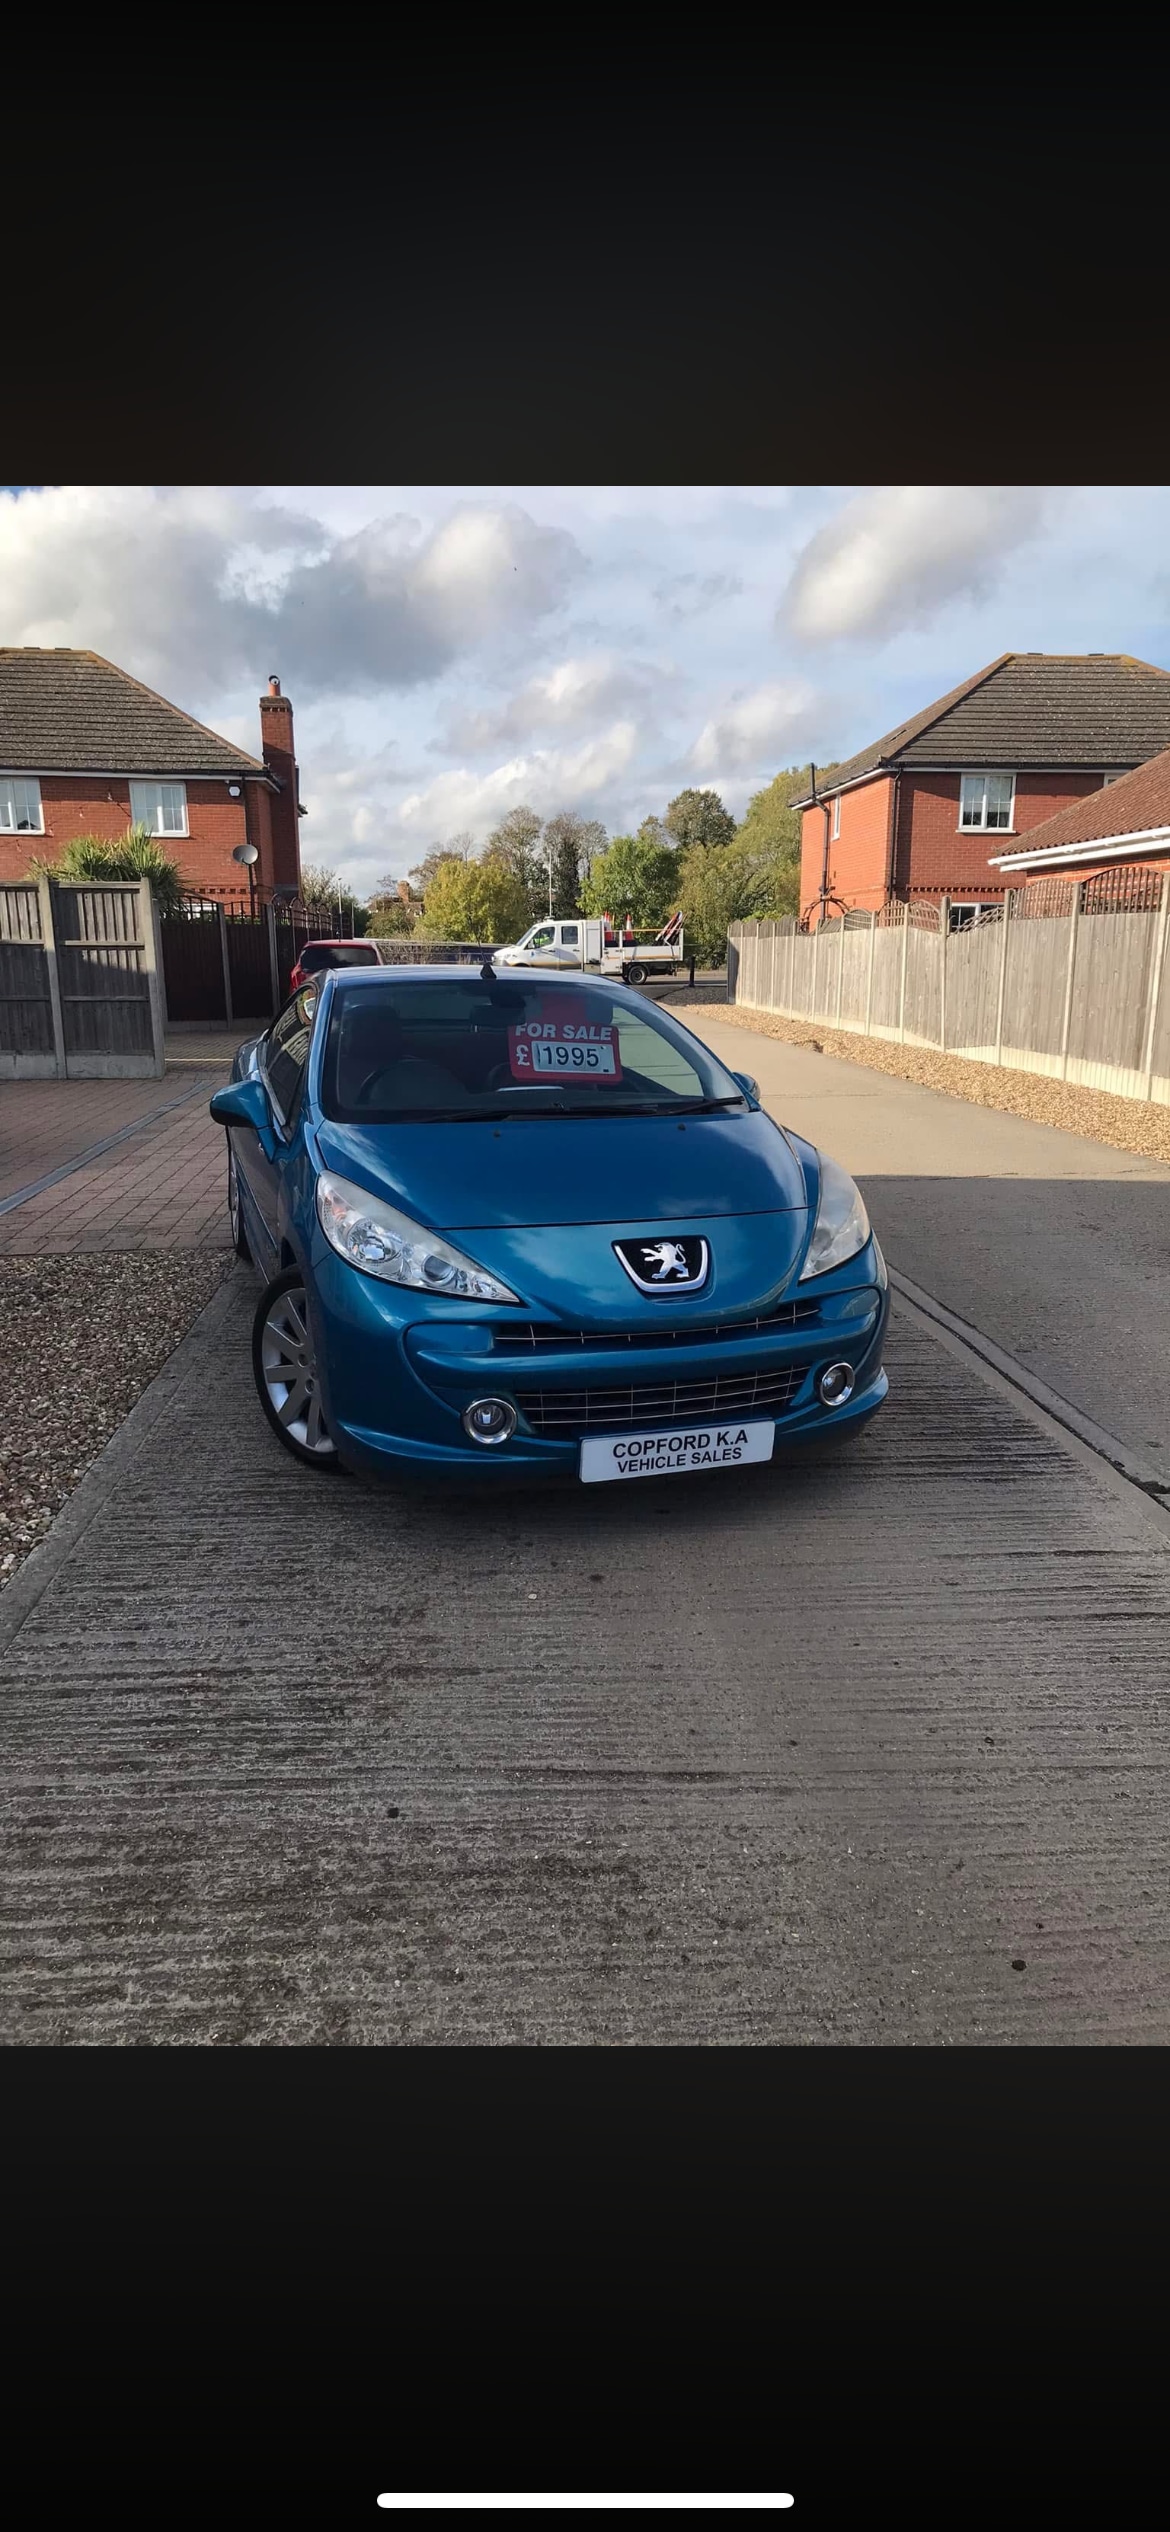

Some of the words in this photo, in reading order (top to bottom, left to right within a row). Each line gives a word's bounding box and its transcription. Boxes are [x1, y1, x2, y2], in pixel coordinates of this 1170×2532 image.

[515, 1023, 556, 1038] FOR
[562, 1025, 612, 1041] SALE
[516, 1044, 530, 1066] £
[543, 1046, 599, 1066] 1995
[613, 1433, 711, 1458] COPFORD
[716, 1429, 748, 1446] K.A
[617, 1453, 686, 1473] VEHICLE
[691, 1447, 742, 1464] SALES
